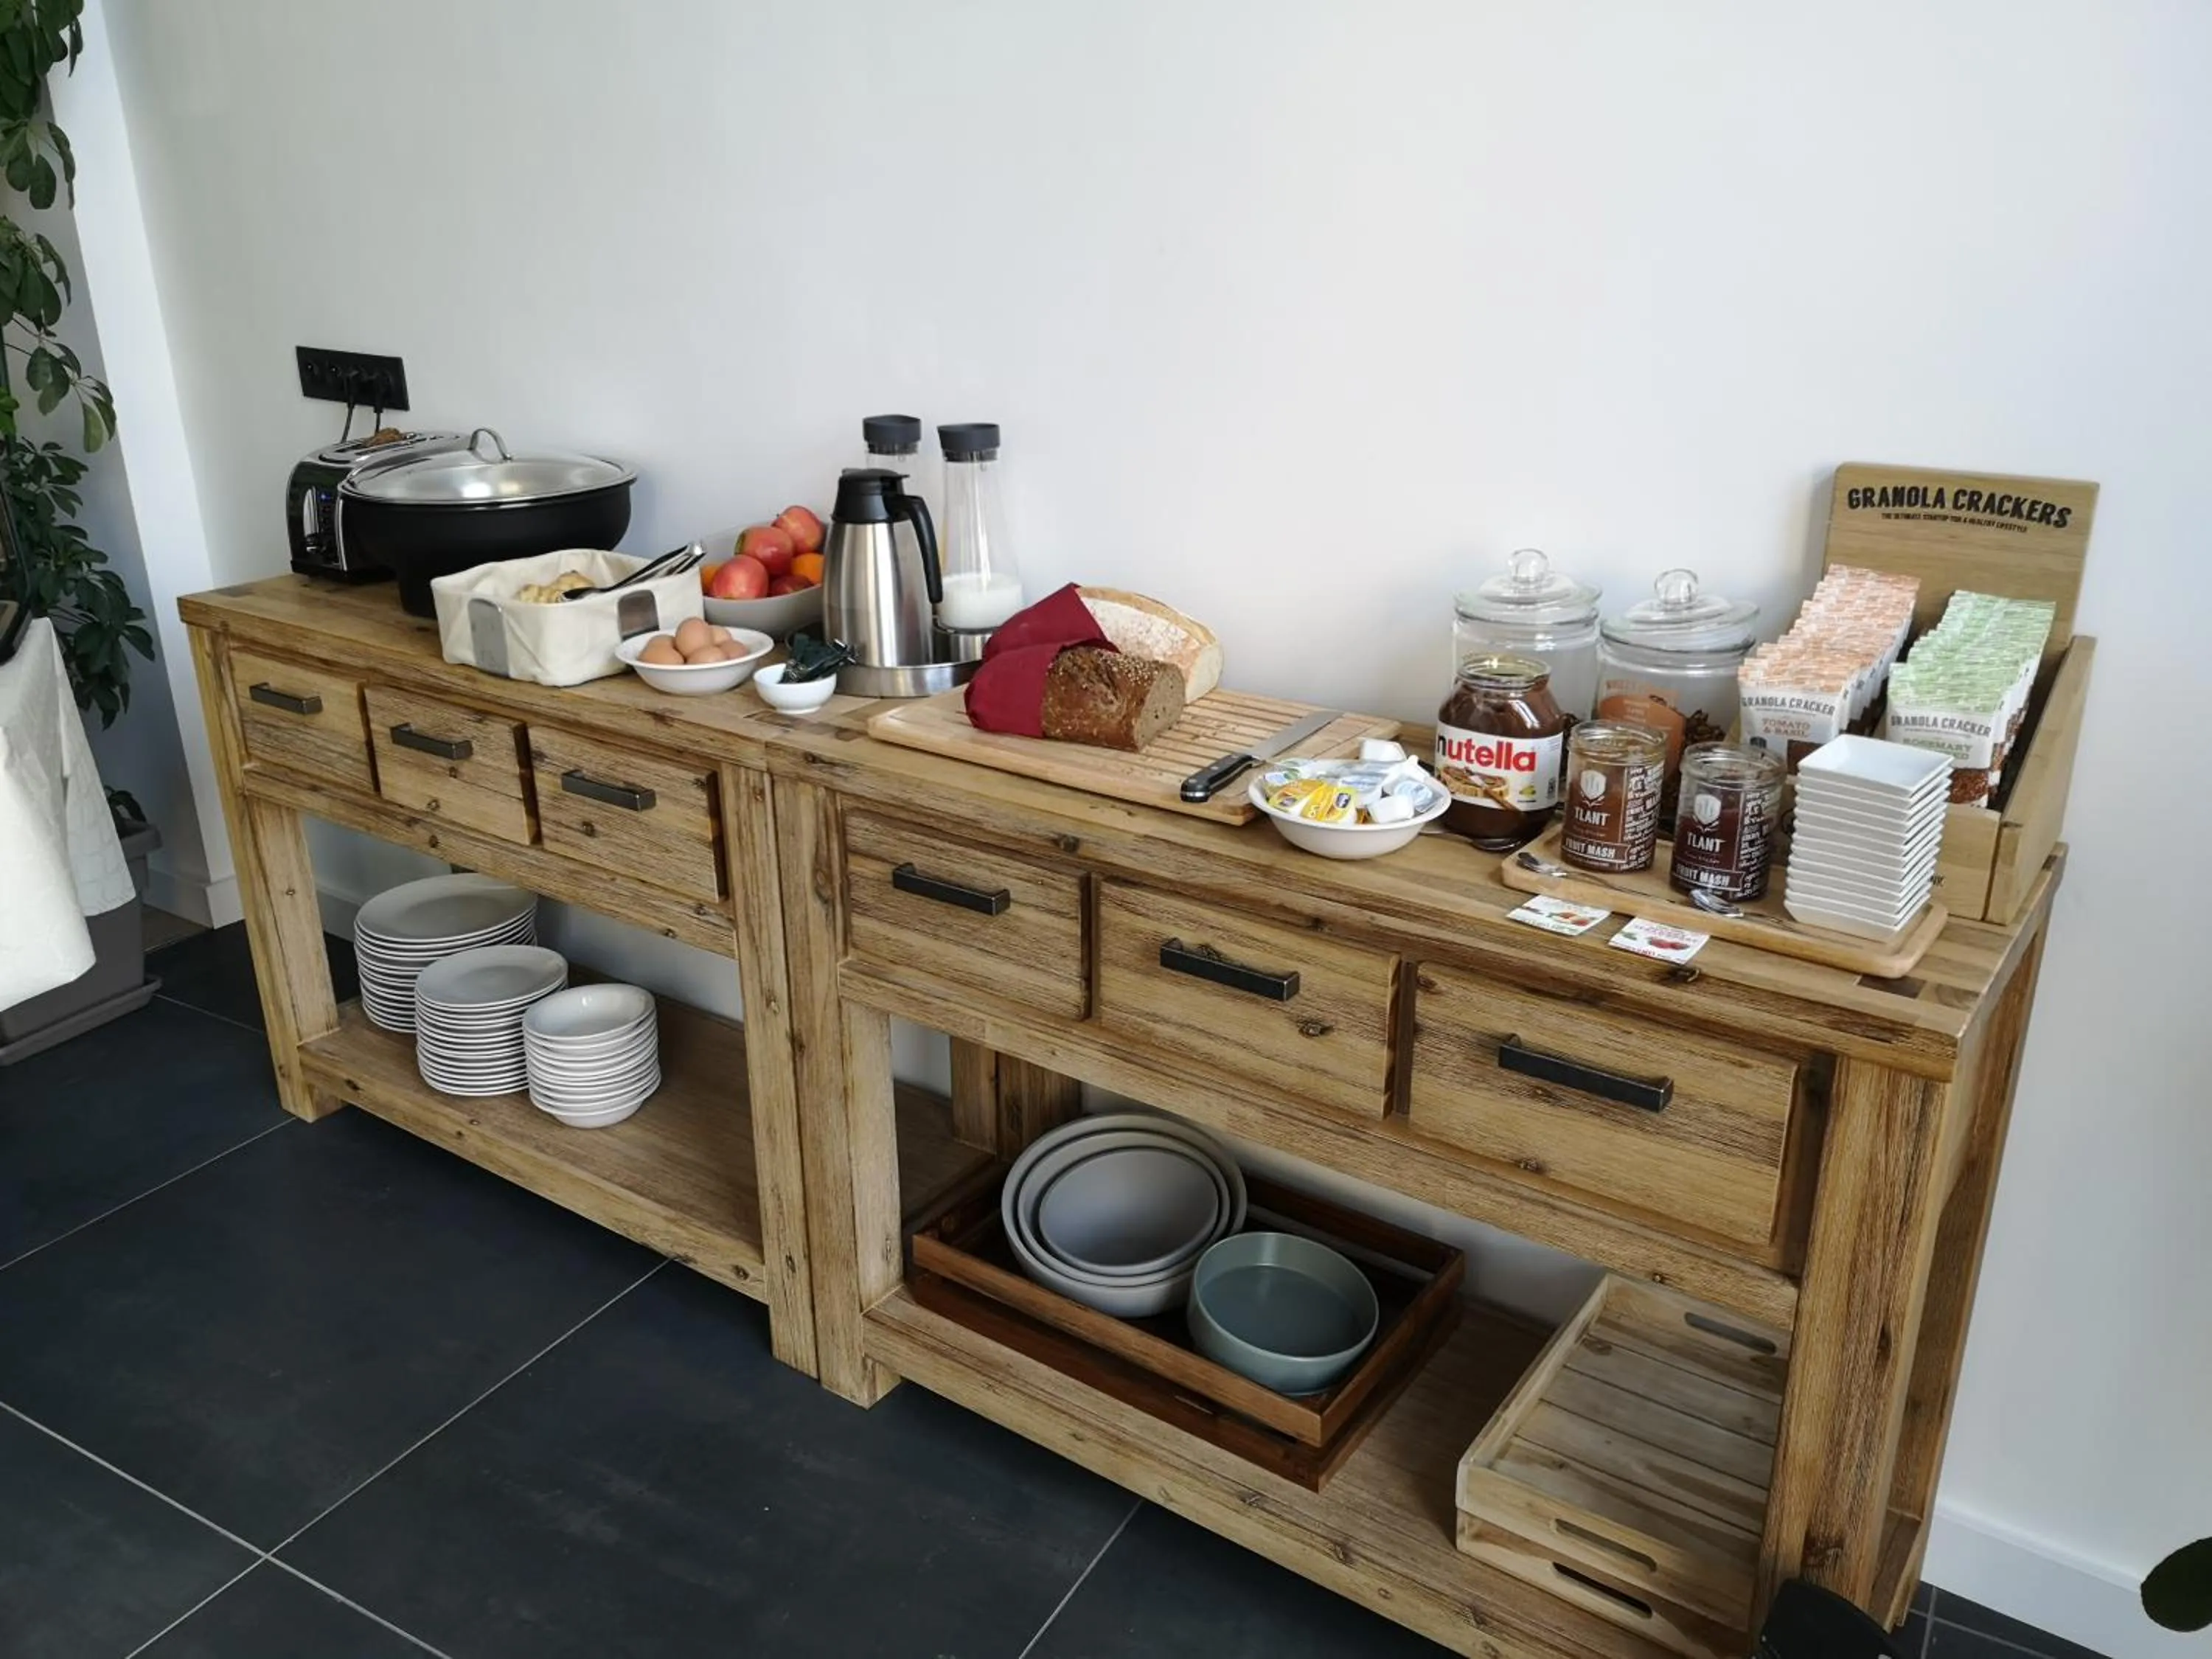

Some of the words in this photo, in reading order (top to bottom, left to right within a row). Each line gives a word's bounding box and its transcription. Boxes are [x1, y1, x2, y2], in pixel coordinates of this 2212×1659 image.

[1848, 485, 1946, 509] GRANOLA
[1952, 488, 2072, 528] CRACKERS
[1995, 521, 2028, 532] LIFESTYLE
[1741, 696, 1787, 707] GRANOLA
[1761, 717, 1811, 731] TOMATO
[1891, 715, 1938, 728] GRANOLA
[1941, 717, 1992, 737] CRACKER
[1437, 736, 1537, 772] nutella
[1902, 738, 1973, 752] ROSEMARY
[1574, 807, 1611, 826] TLANT
[1565, 837, 1586, 855] FRUIT
[1587, 844, 1616, 860] MASH
[1686, 831, 1726, 853] TLANT
[1676, 863, 1698, 880] FRUIT
[1699, 871, 1731, 888] MASH
